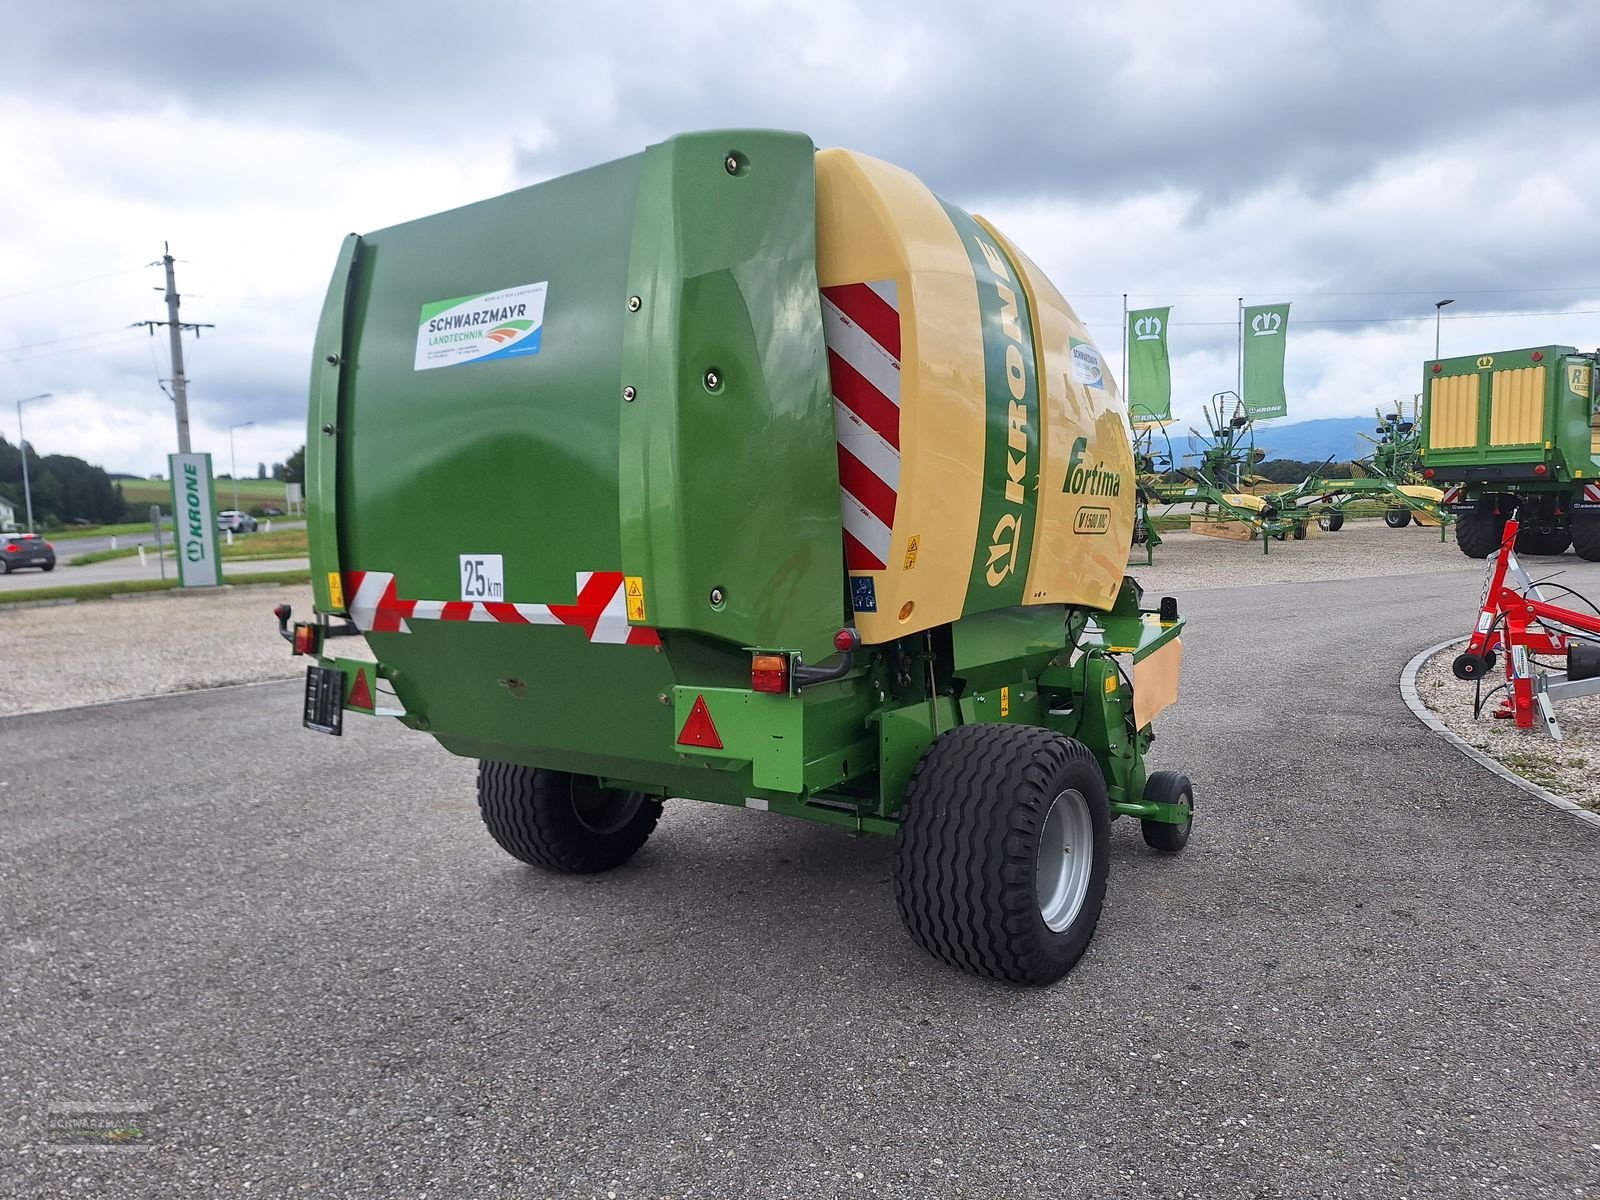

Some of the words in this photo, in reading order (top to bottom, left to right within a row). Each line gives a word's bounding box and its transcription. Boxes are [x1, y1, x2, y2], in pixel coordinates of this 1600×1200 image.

[429, 303, 526, 333] SCHWARZMAYR
[428, 329, 484, 346] LANDTECHNIK
[973, 234, 1029, 505] KRONE
[1256, 405, 1282, 413] KRONE
[184, 463, 204, 538] KRONE
[1078, 512, 1086, 528] V
[464, 560, 486, 597] 25
[487, 577, 502, 597] km
